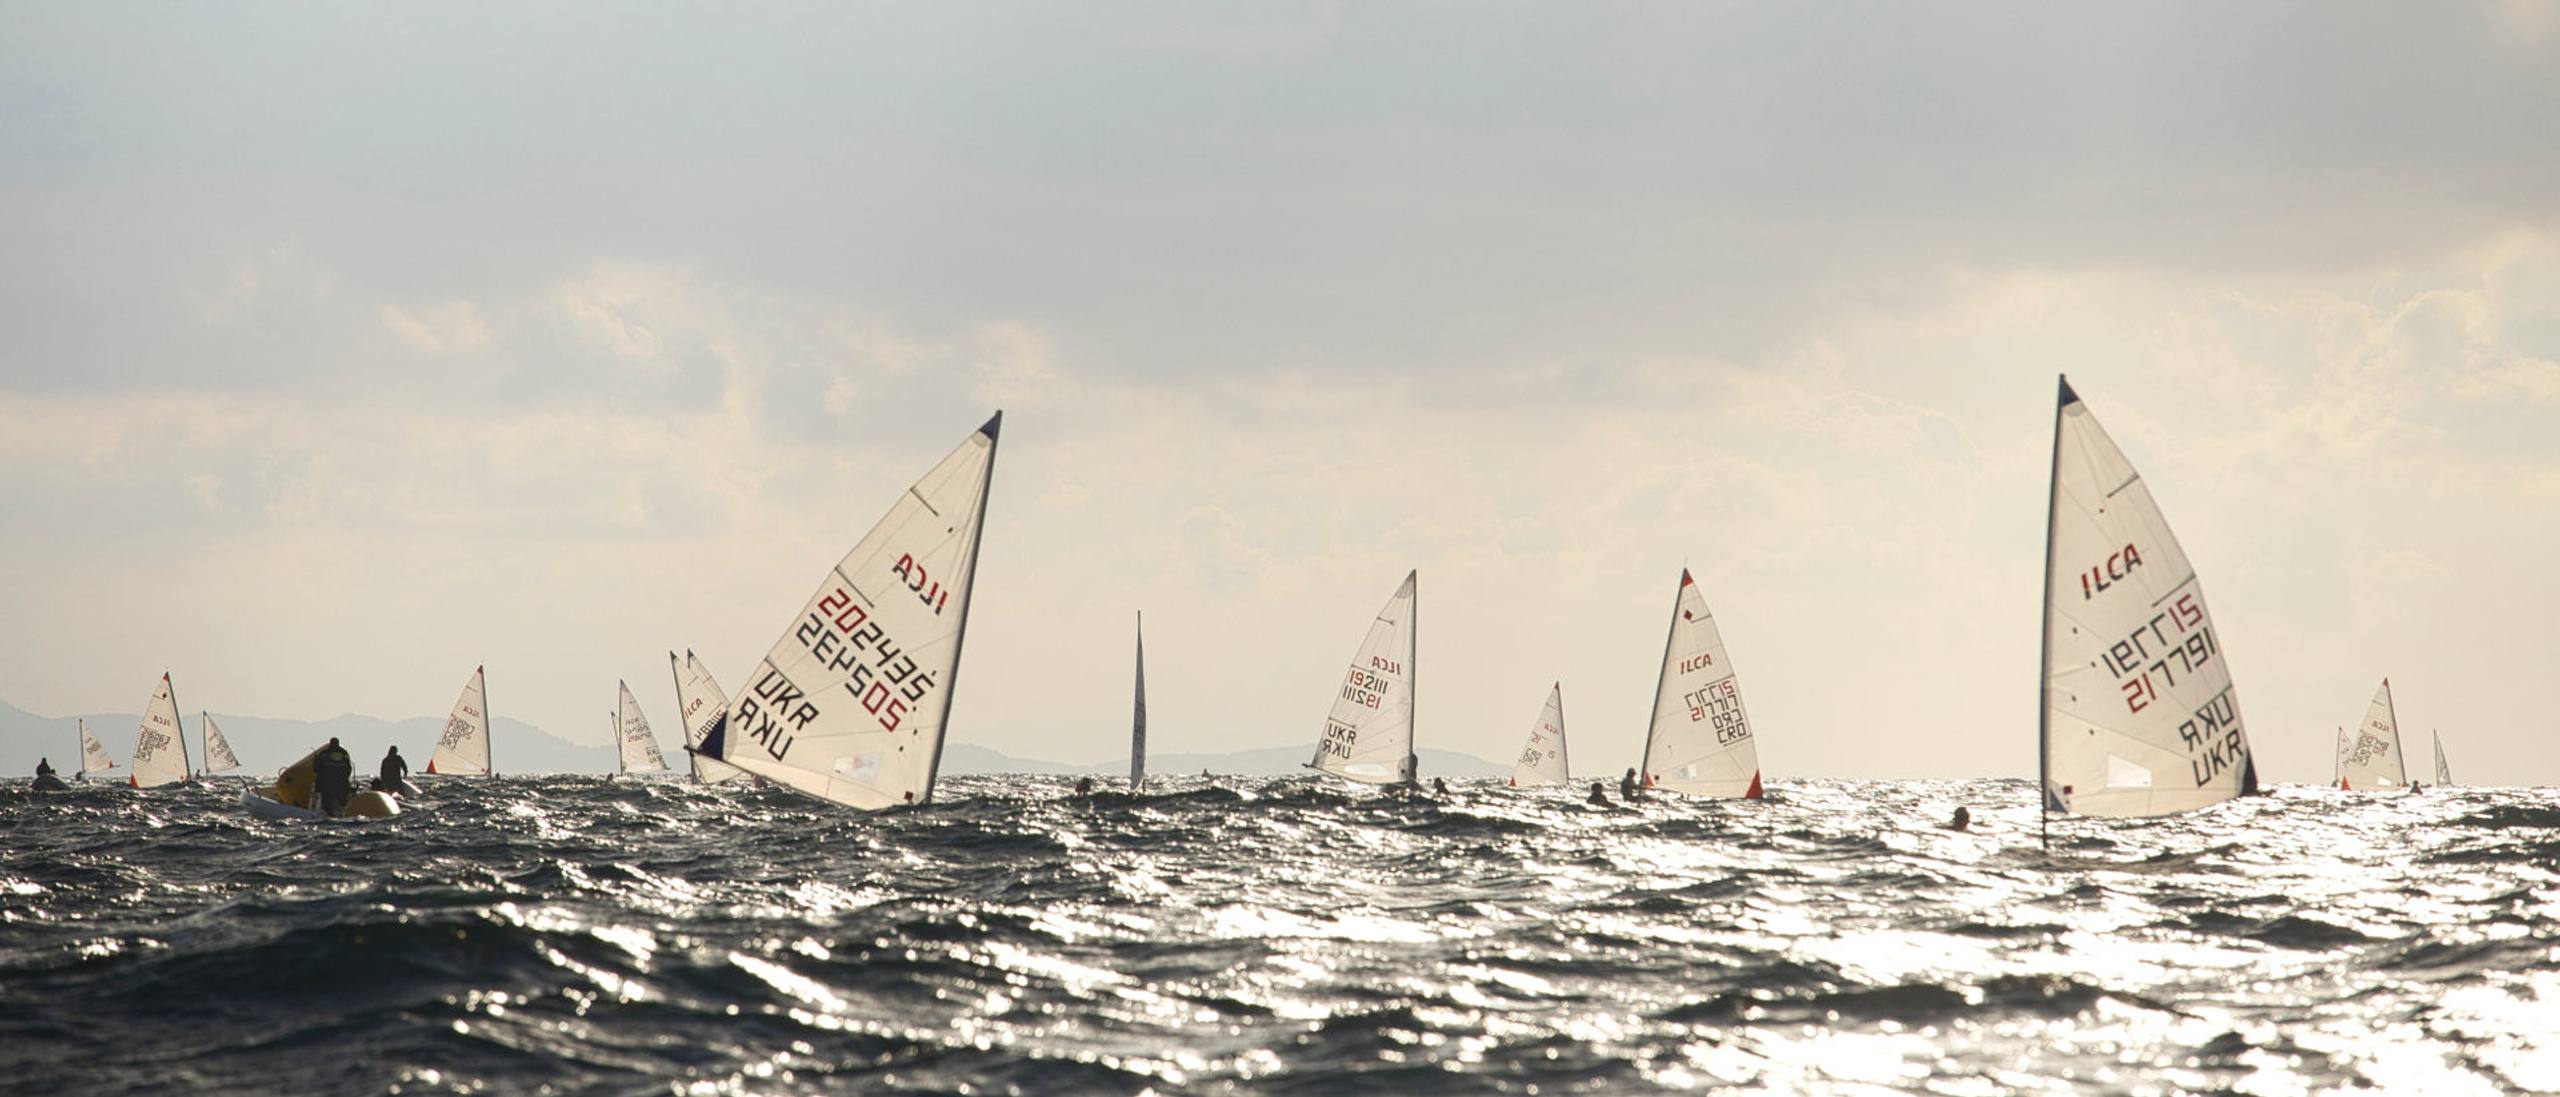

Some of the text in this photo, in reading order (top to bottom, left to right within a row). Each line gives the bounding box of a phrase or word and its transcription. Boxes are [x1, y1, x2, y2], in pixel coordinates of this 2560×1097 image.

[2080, 543, 2142, 600] ILCA
[817, 587, 936, 702] 202435
[1680, 653, 1713, 675] ILCA
[2120, 626, 2217, 714] 217791
[753, 669, 820, 732] UKR
[1349, 670, 1389, 695] 192111
[1327, 723, 1357, 746] UKR
[1717, 722, 1747, 745] CRO
[2192, 727, 2244, 788] UKR
